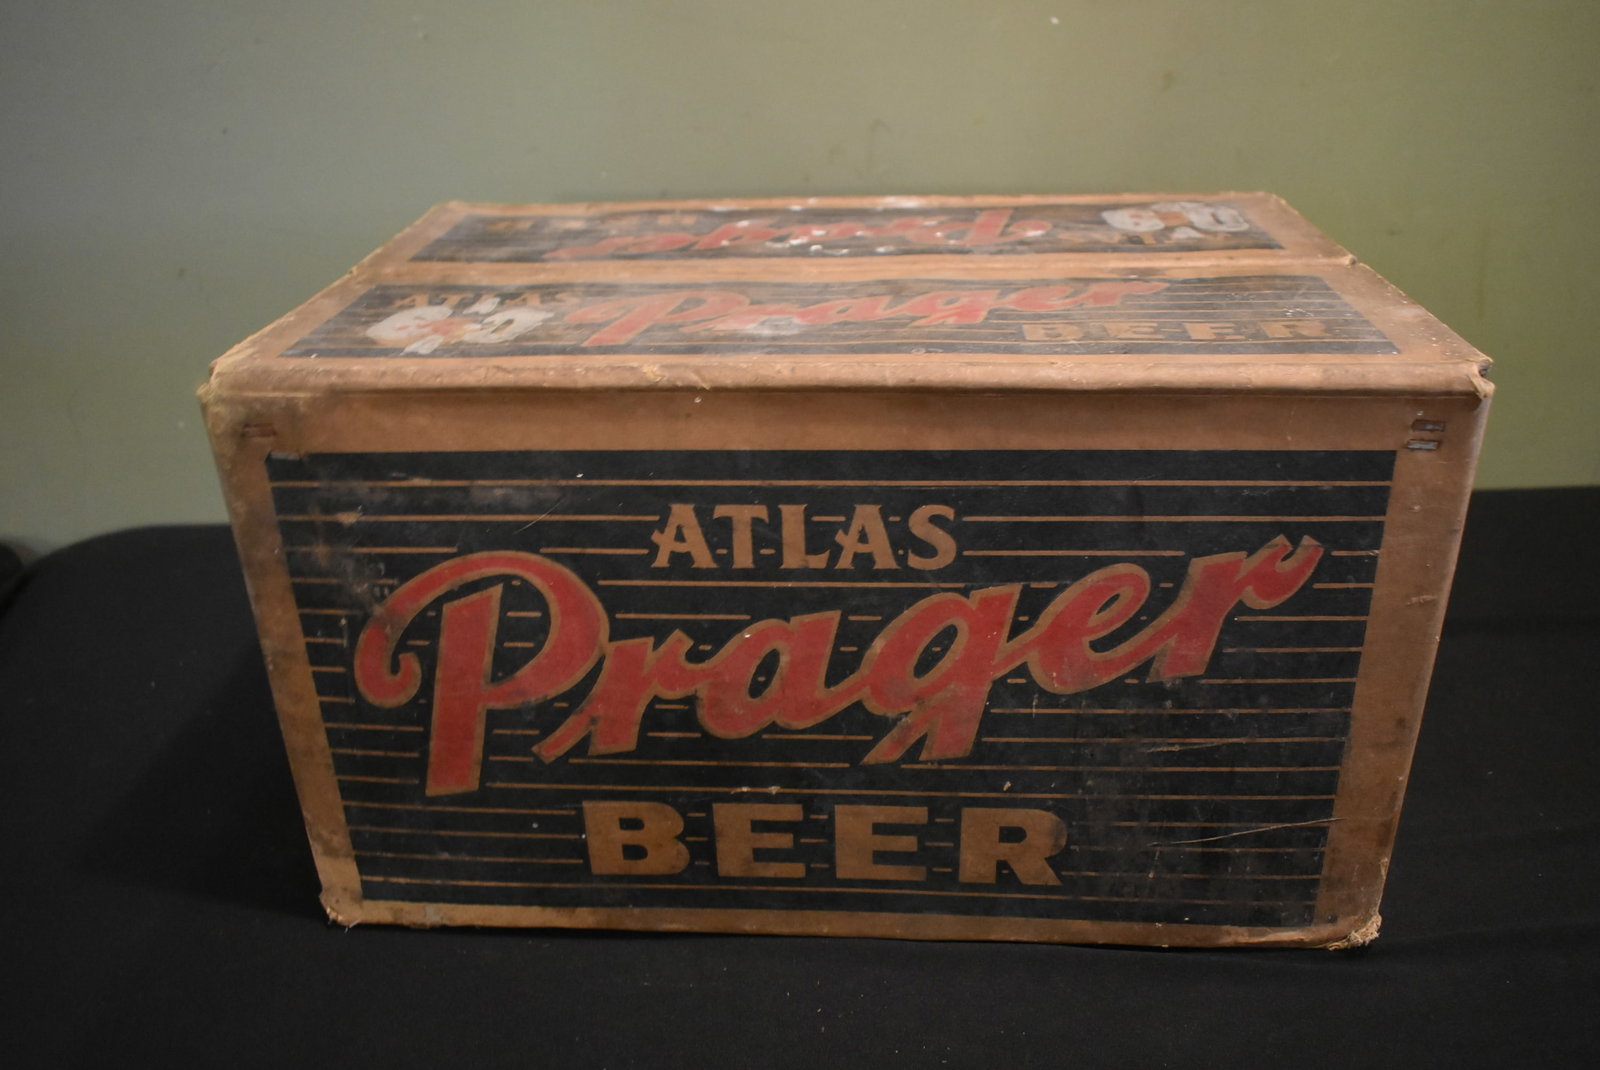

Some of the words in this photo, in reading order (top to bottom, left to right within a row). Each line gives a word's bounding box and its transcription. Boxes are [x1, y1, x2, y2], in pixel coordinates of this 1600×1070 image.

[564, 279, 1171, 347] Prager
[1022, 320, 1337, 342] BEER
[651, 503, 958, 571] ATLAS
[353, 533, 1325, 797] Prager
[581, 800, 1069, 887] BEER
